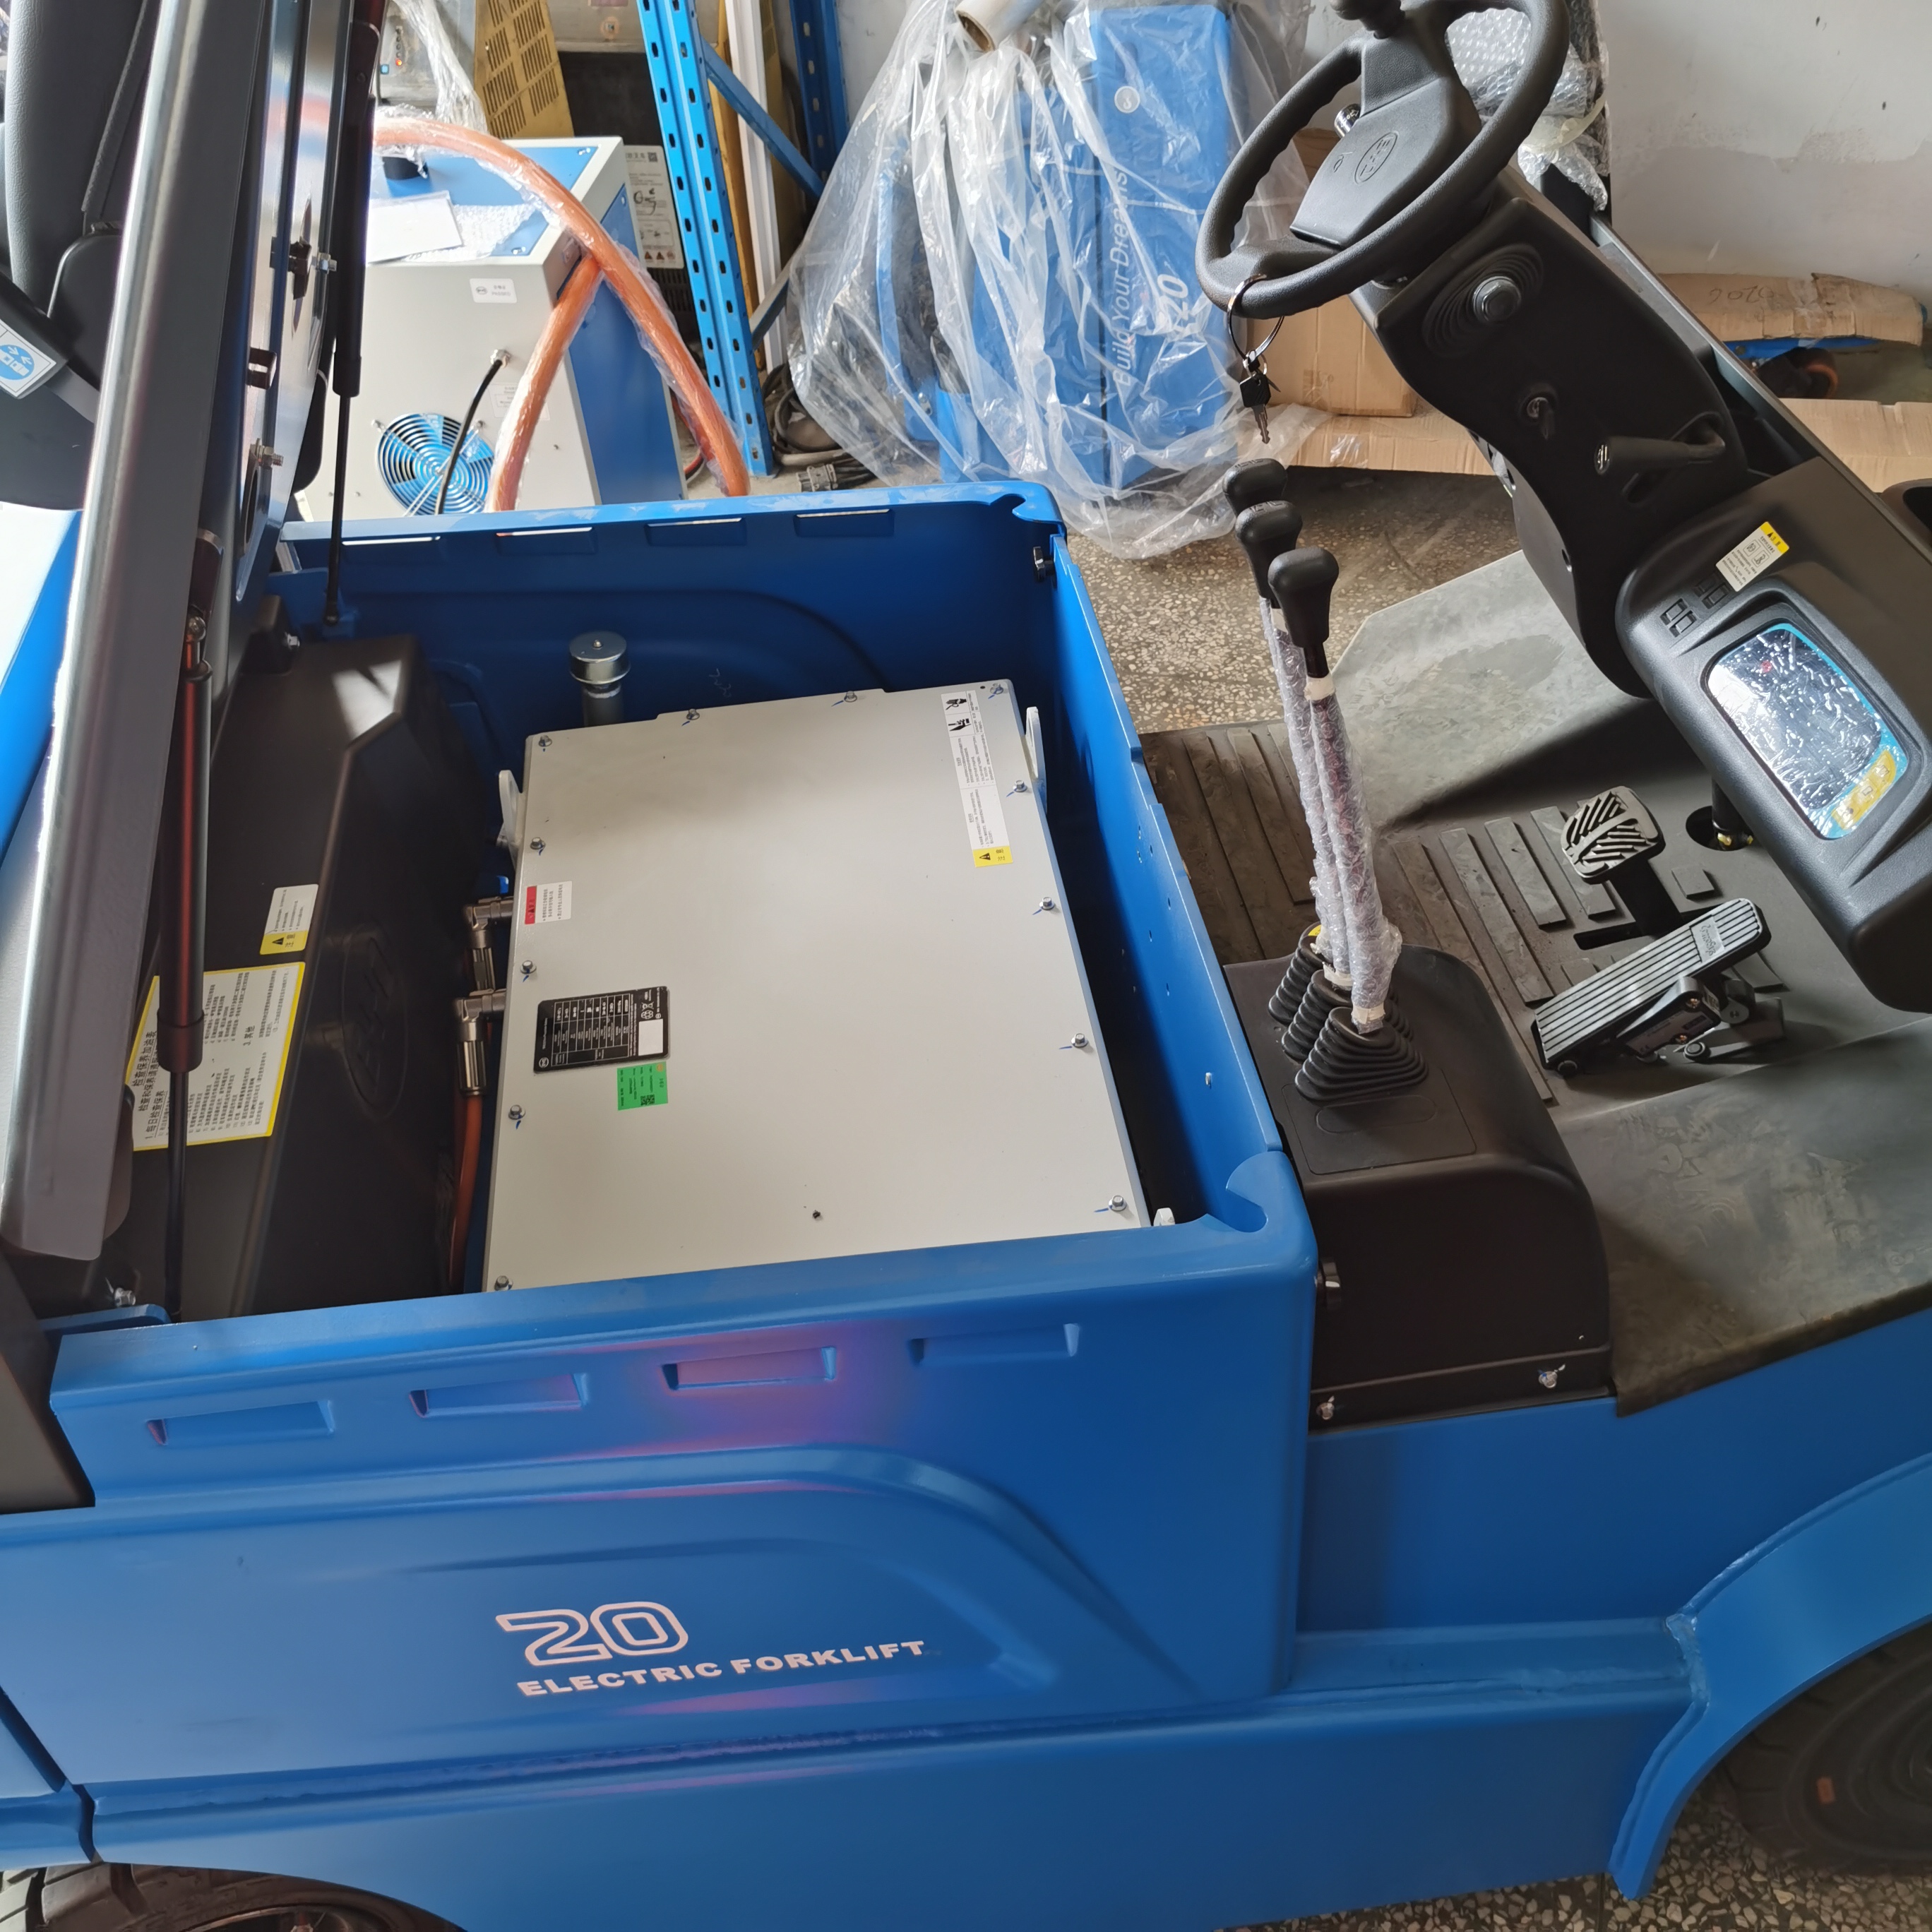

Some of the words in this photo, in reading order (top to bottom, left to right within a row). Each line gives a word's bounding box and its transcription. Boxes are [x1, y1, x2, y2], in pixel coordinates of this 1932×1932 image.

[1111, 272, 1131, 321] Your
[1111, 330, 1132, 386] Build
[495, 1601, 689, 1666] 20
[517, 1662, 722, 1696] ELECTRIC
[730, 1640, 924, 1674] FORKLIFT
